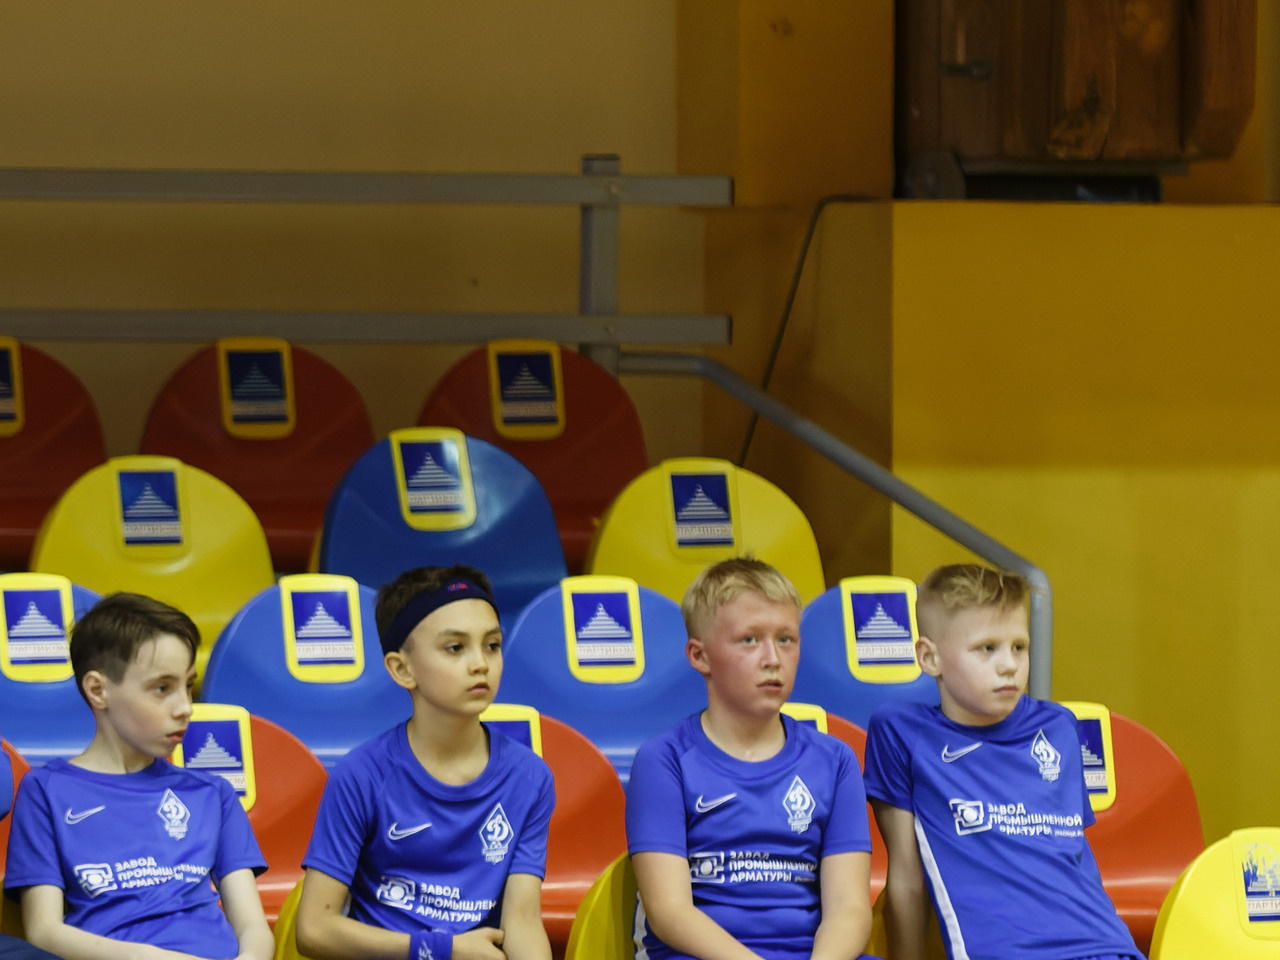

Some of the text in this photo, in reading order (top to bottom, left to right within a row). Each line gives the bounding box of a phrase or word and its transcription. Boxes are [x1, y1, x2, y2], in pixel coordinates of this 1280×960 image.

[114, 856, 157, 873] ЗАВОД
[729, 871, 792, 883] АРМАТУРЫ
[420, 883, 461, 900] ЗАВОД
[415, 905, 482, 923] АРМАТУРЫ
